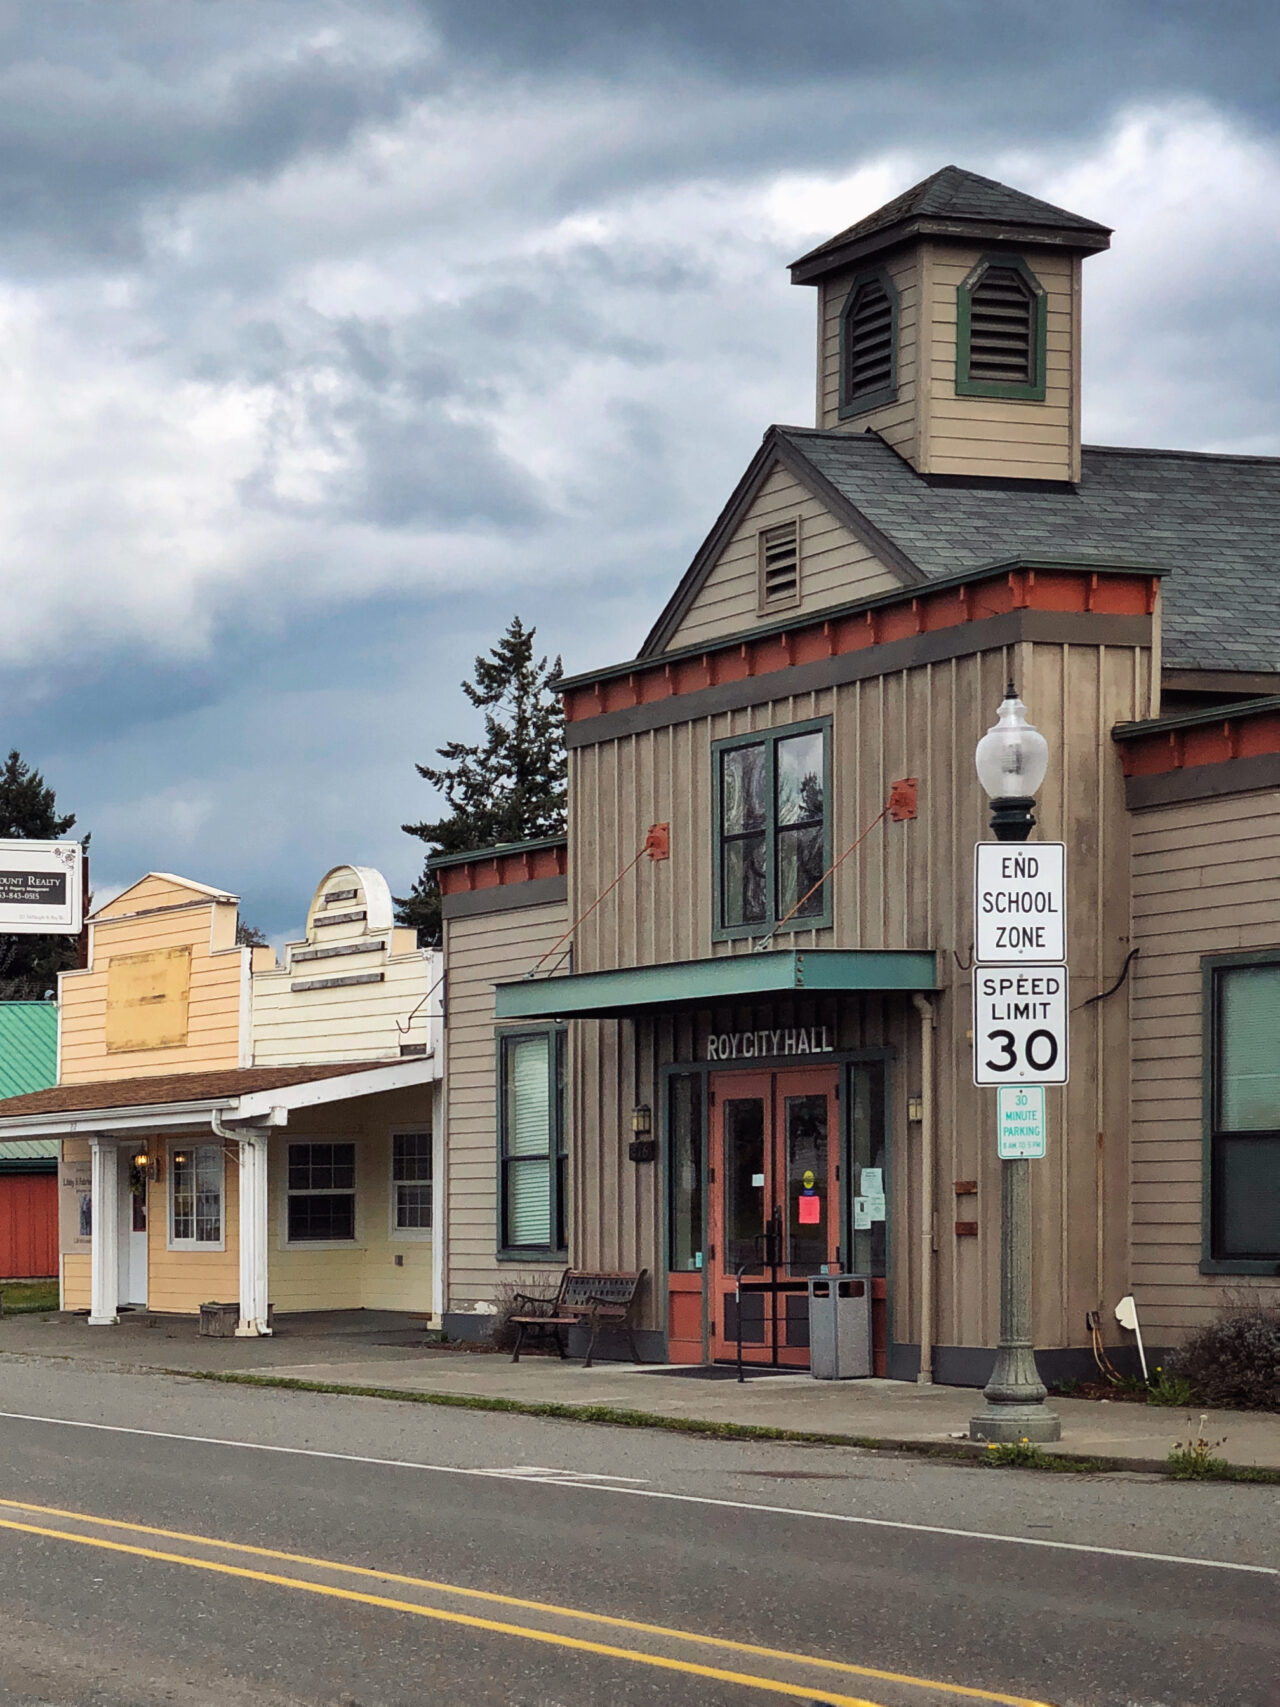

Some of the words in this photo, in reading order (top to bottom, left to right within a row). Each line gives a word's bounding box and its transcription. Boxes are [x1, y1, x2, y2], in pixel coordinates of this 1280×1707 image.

[1002, 857, 1039, 878] END
[28, 876, 61, 886] REALTY
[982, 891, 1058, 913] SCHOOL
[996, 926, 1045, 948] ZONE
[983, 978, 1060, 996] SPEED
[991, 1002, 1051, 1020] LIMIT
[707, 1033, 739, 1060] ROY
[743, 1030, 780, 1057] CITY
[784, 1026, 834, 1055] HALL
[985, 1029, 1058, 1072] 30
[1015, 1095, 1028, 1106] 30
[1005, 1110, 1037, 1121] MINUTE
[1003, 1127, 1040, 1137] PARKING
